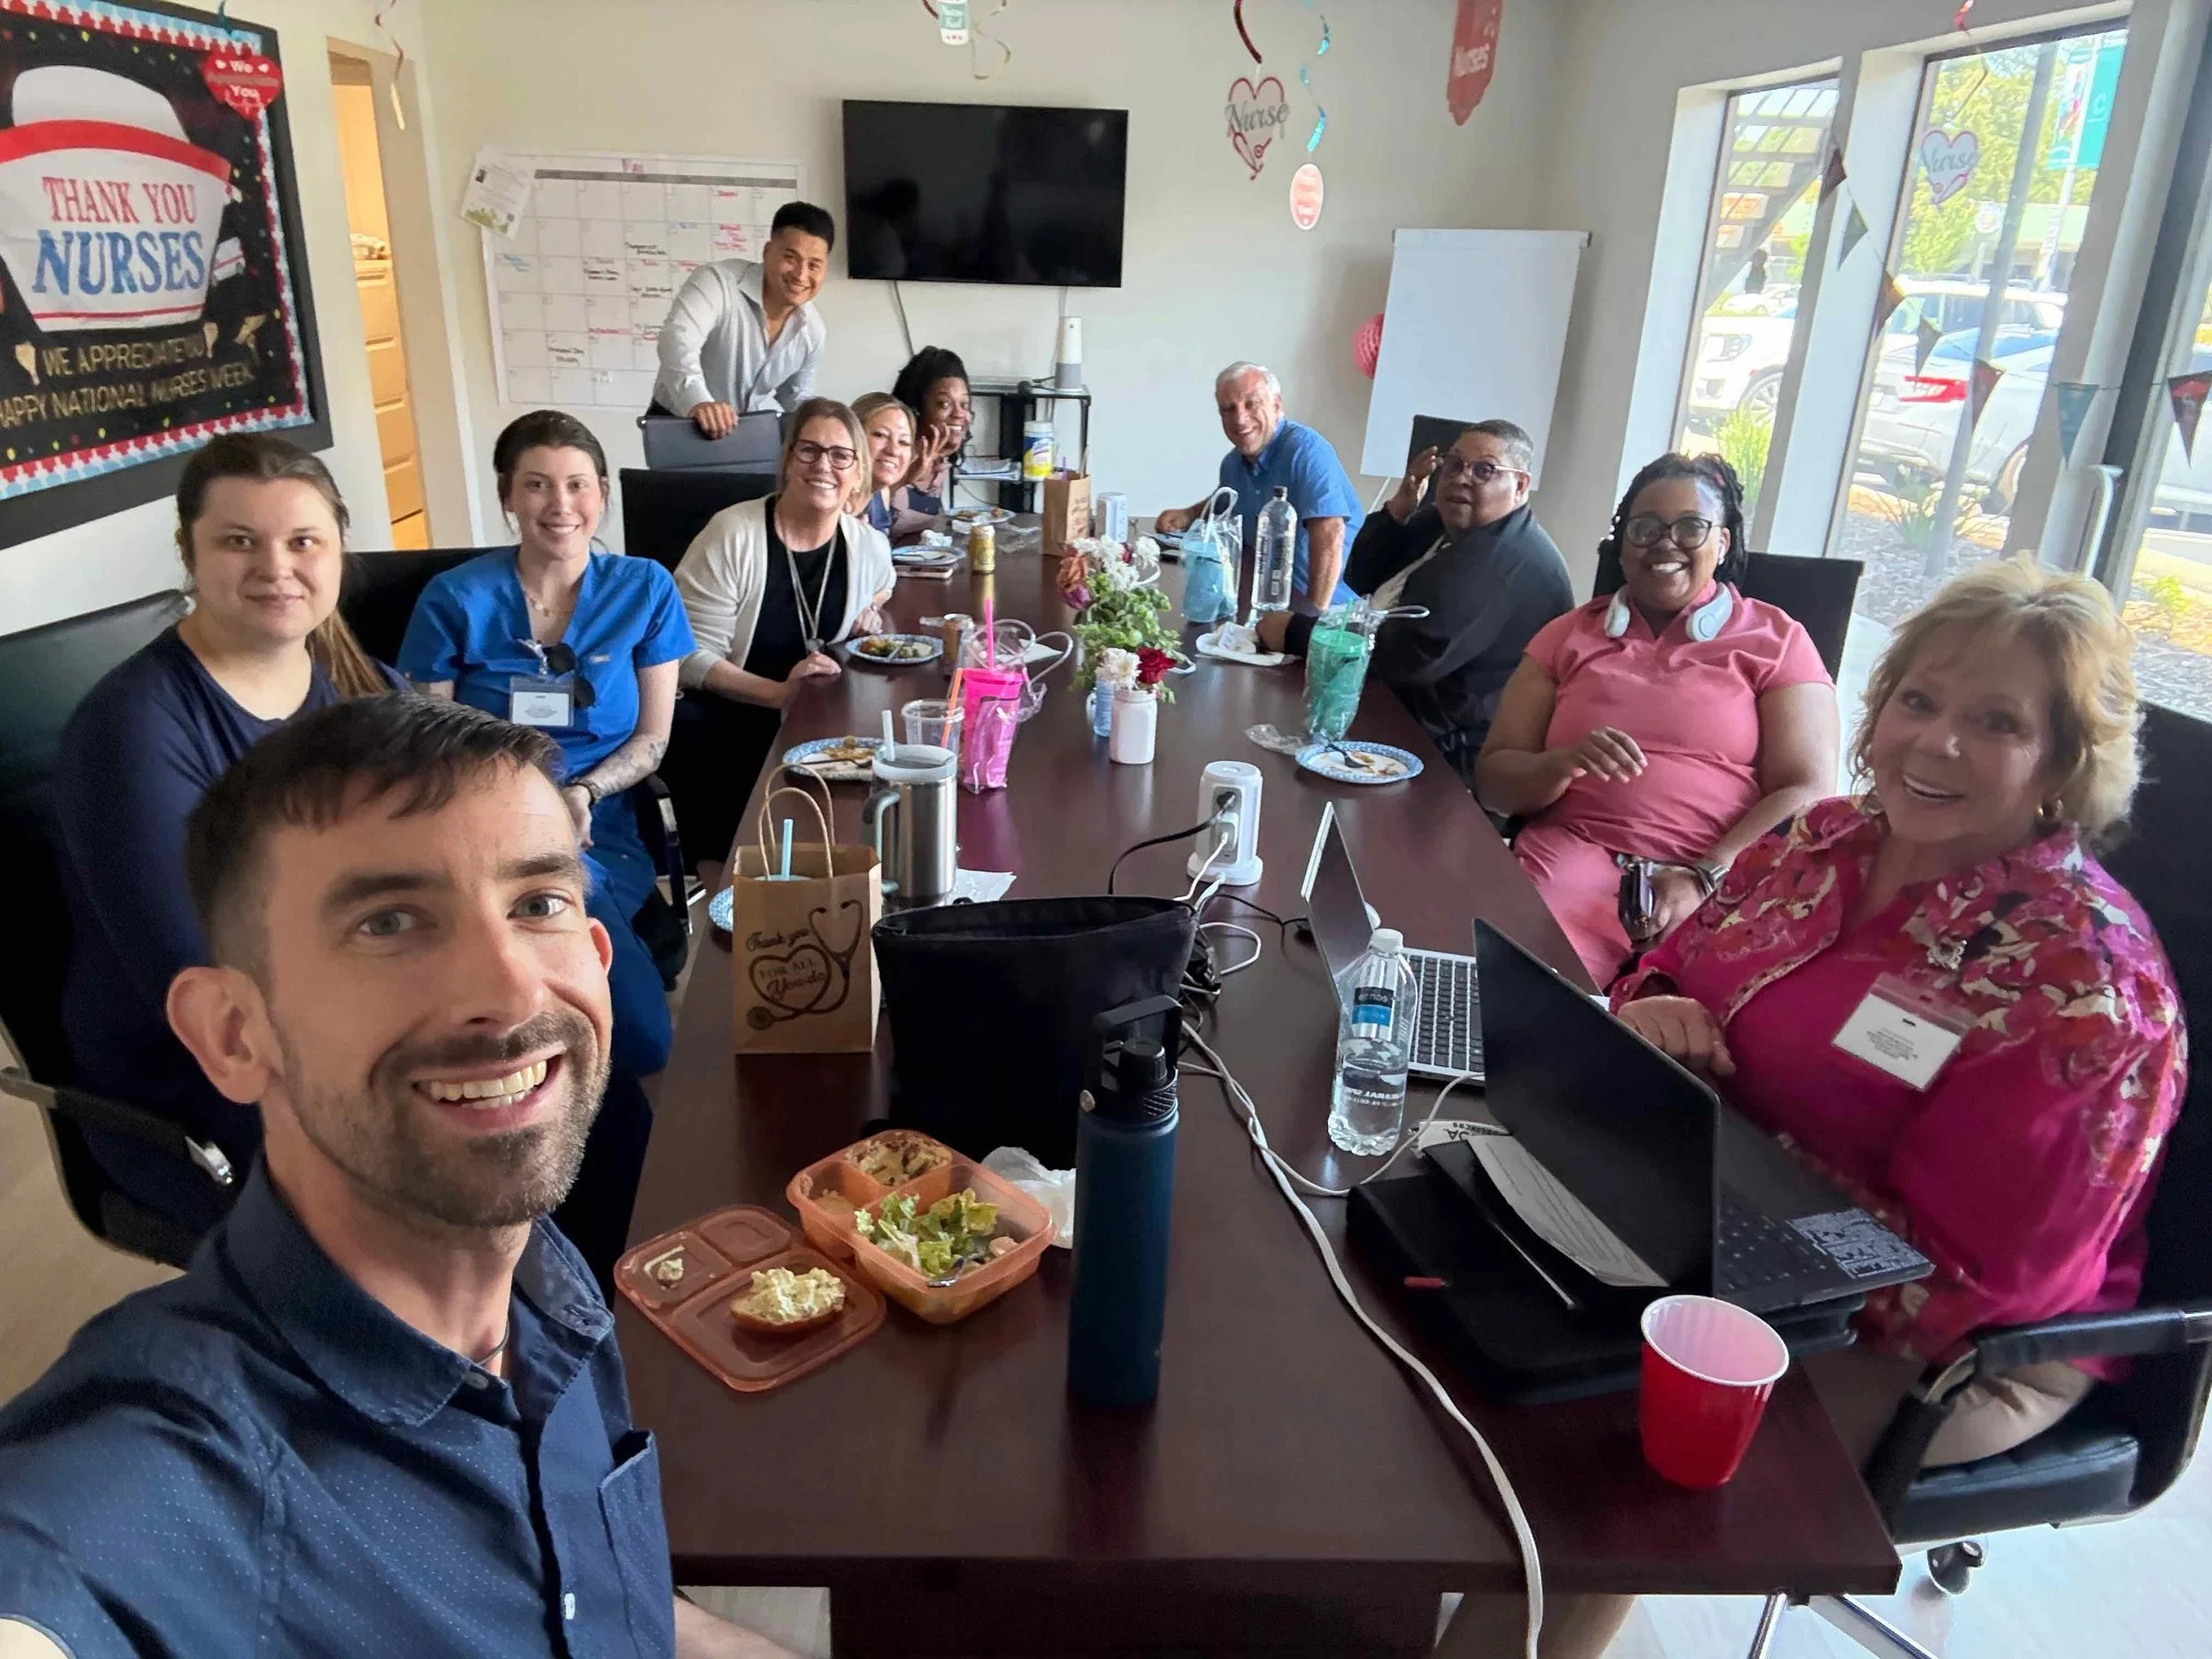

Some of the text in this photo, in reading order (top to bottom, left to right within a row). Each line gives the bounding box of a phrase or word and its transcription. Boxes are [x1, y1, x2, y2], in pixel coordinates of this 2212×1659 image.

[229, 60, 254, 73] We
[230, 84, 262, 102] You
[1225, 100, 1291, 135] Nurse
[42, 176, 196, 224] THANK YOU
[32, 229, 205, 296] NURSES
[42, 347, 73, 377] WE
[0, 359, 255, 429] APPY NATIONAL NURSES WEEK
[746, 930, 786, 952] Thank
[793, 956, 815, 972] ALL
